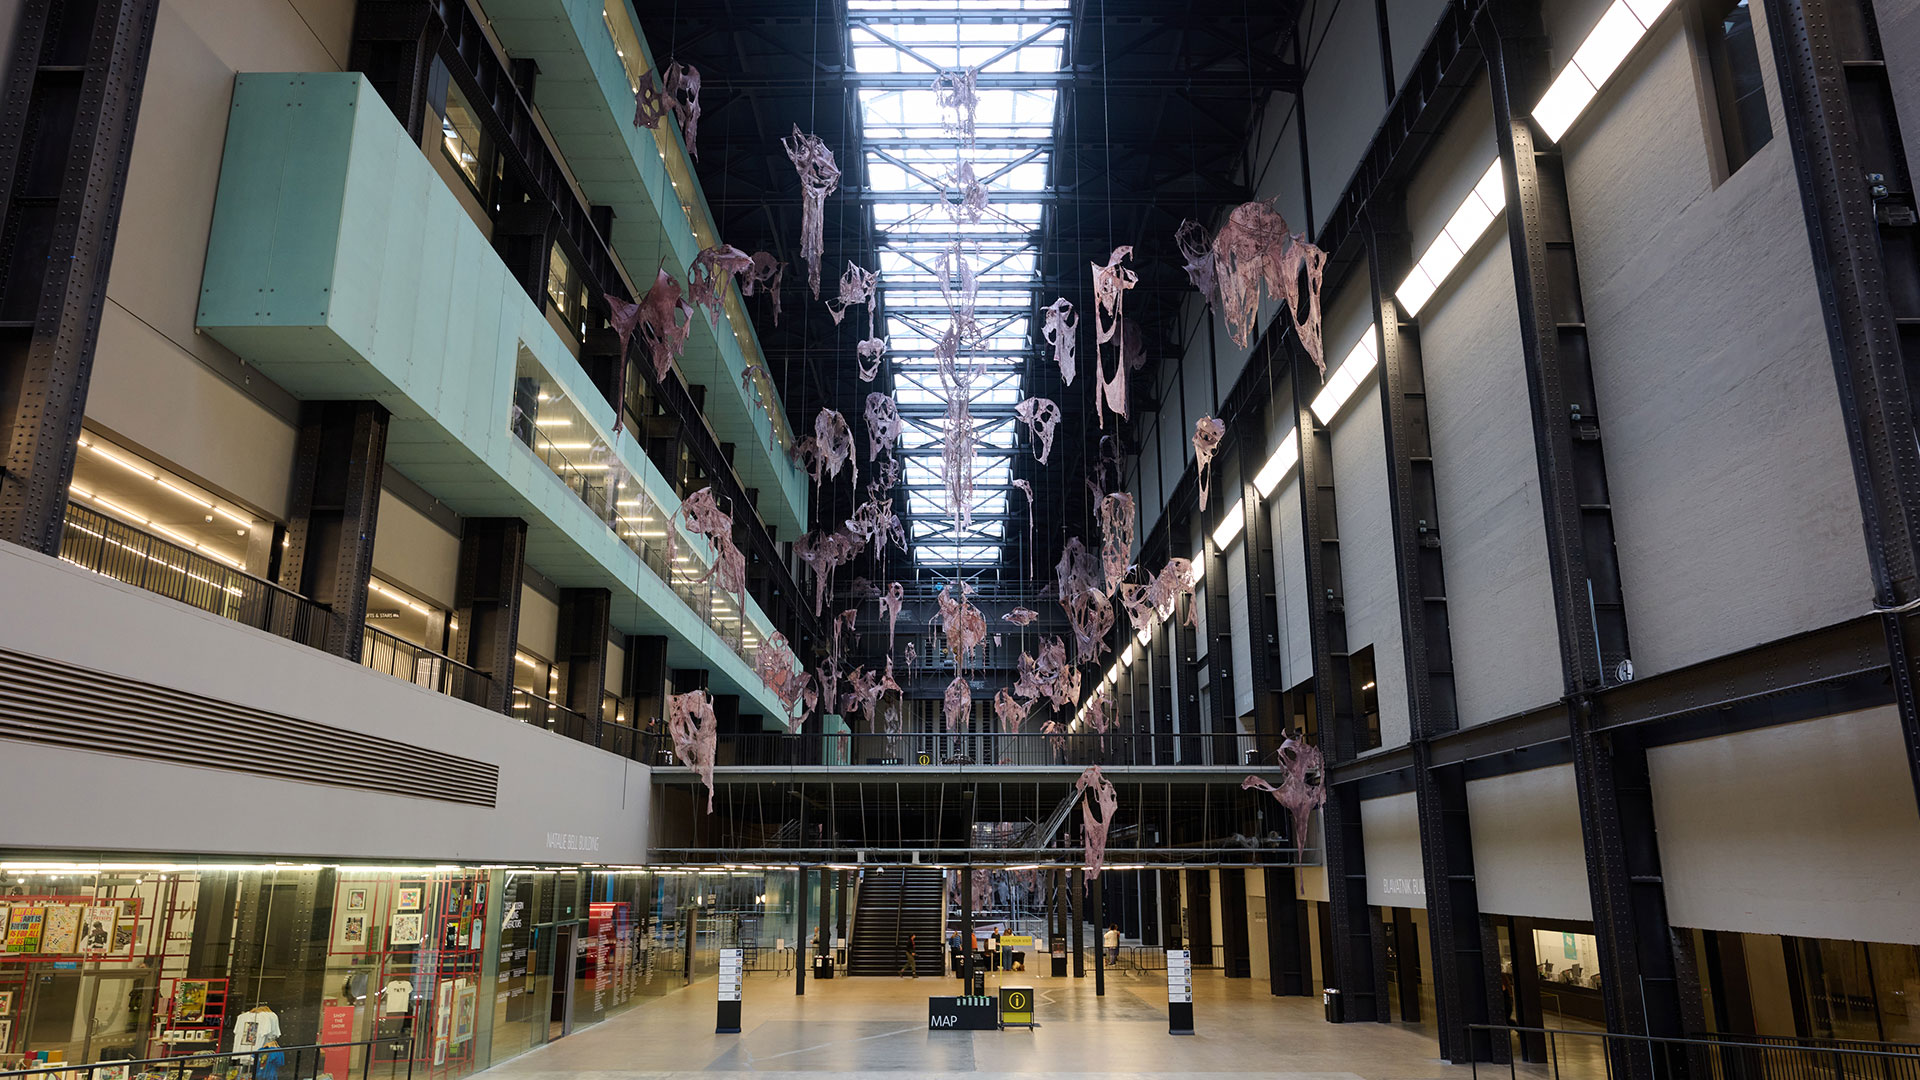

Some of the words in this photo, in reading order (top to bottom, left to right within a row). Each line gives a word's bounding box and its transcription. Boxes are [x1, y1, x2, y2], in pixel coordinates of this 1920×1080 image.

[547, 832, 566, 850] NATALIE
[568, 834, 578, 850] BELL
[578, 835, 599, 852] BUILDING
[1383, 878, 1412, 894] BLAVATNIK
[931, 1015, 957, 1027] MAP
